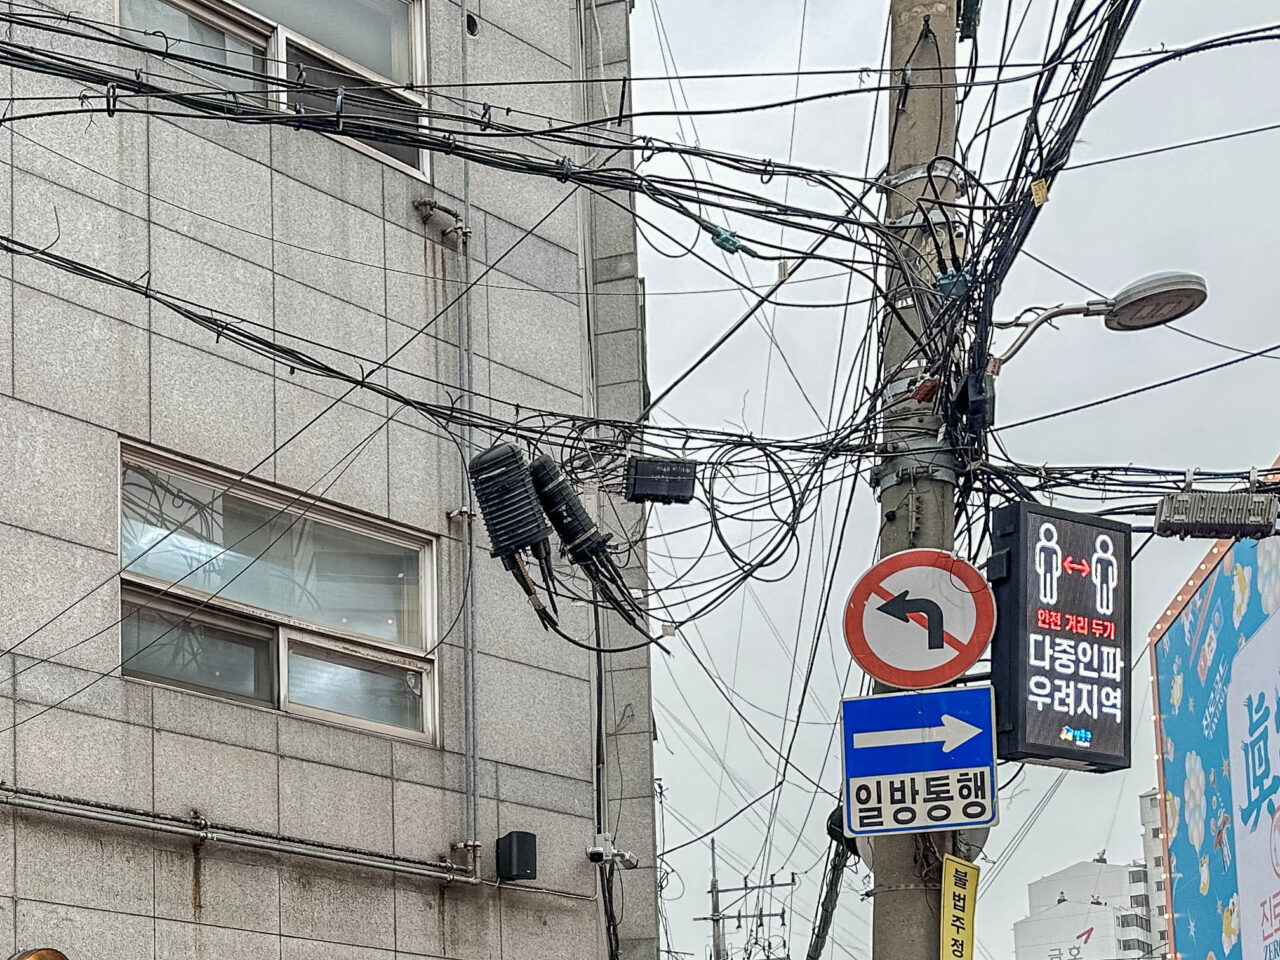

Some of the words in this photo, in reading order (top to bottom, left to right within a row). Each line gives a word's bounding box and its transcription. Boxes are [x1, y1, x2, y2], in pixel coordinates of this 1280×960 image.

[1037, 608, 1062, 631] 안전
[1065, 612, 1088, 635] 거리
[1091, 618, 1116, 640] 두기
[1028, 633, 1124, 683] 다중인파
[1027, 675, 1122, 724] 우려지역
[854, 770, 987, 829] 일방통행
